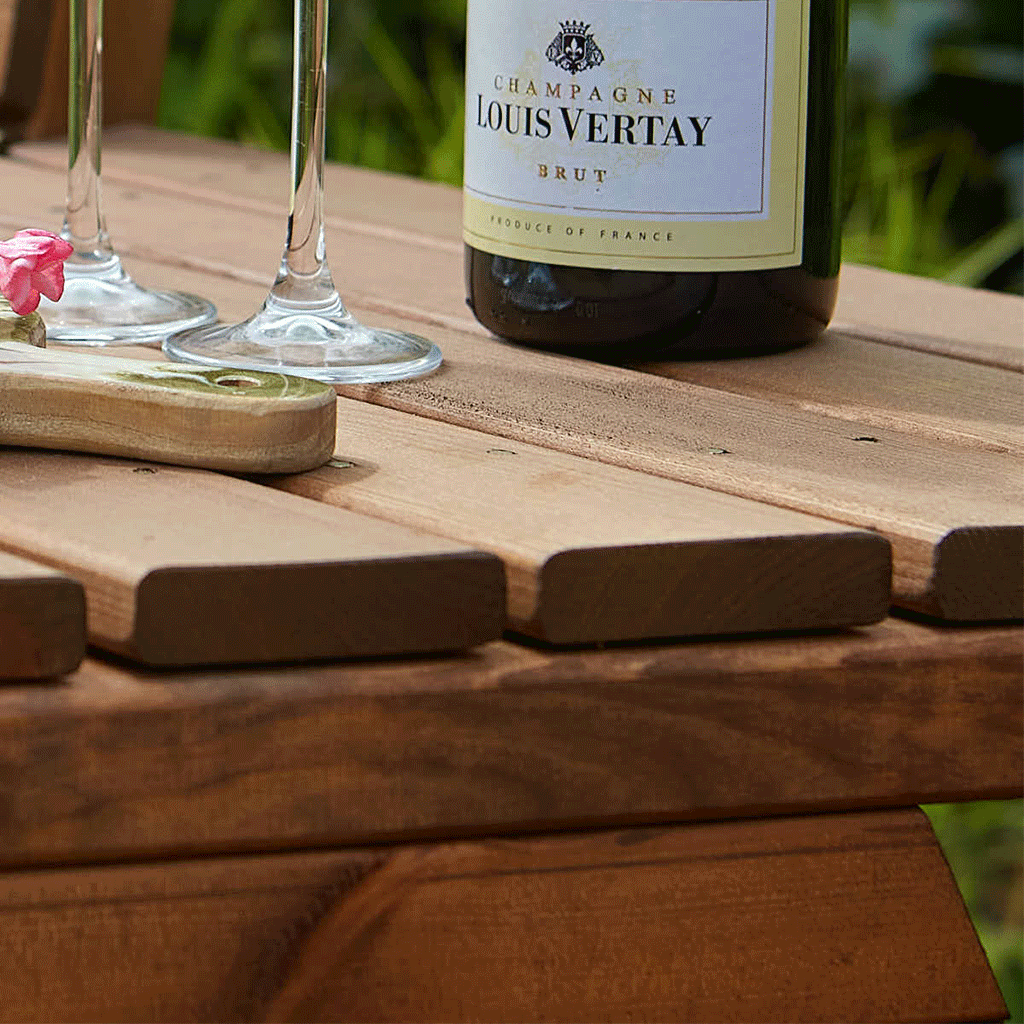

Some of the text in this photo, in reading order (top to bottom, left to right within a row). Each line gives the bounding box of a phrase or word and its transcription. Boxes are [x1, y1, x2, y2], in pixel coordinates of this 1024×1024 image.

[493, 74, 677, 105] CHAMPAGNE
[475, 92, 712, 147] LOUIS VERTAY
[537, 163, 607, 184] BRUT
[490, 214, 674, 242] PRODUCE OF FRANCE
